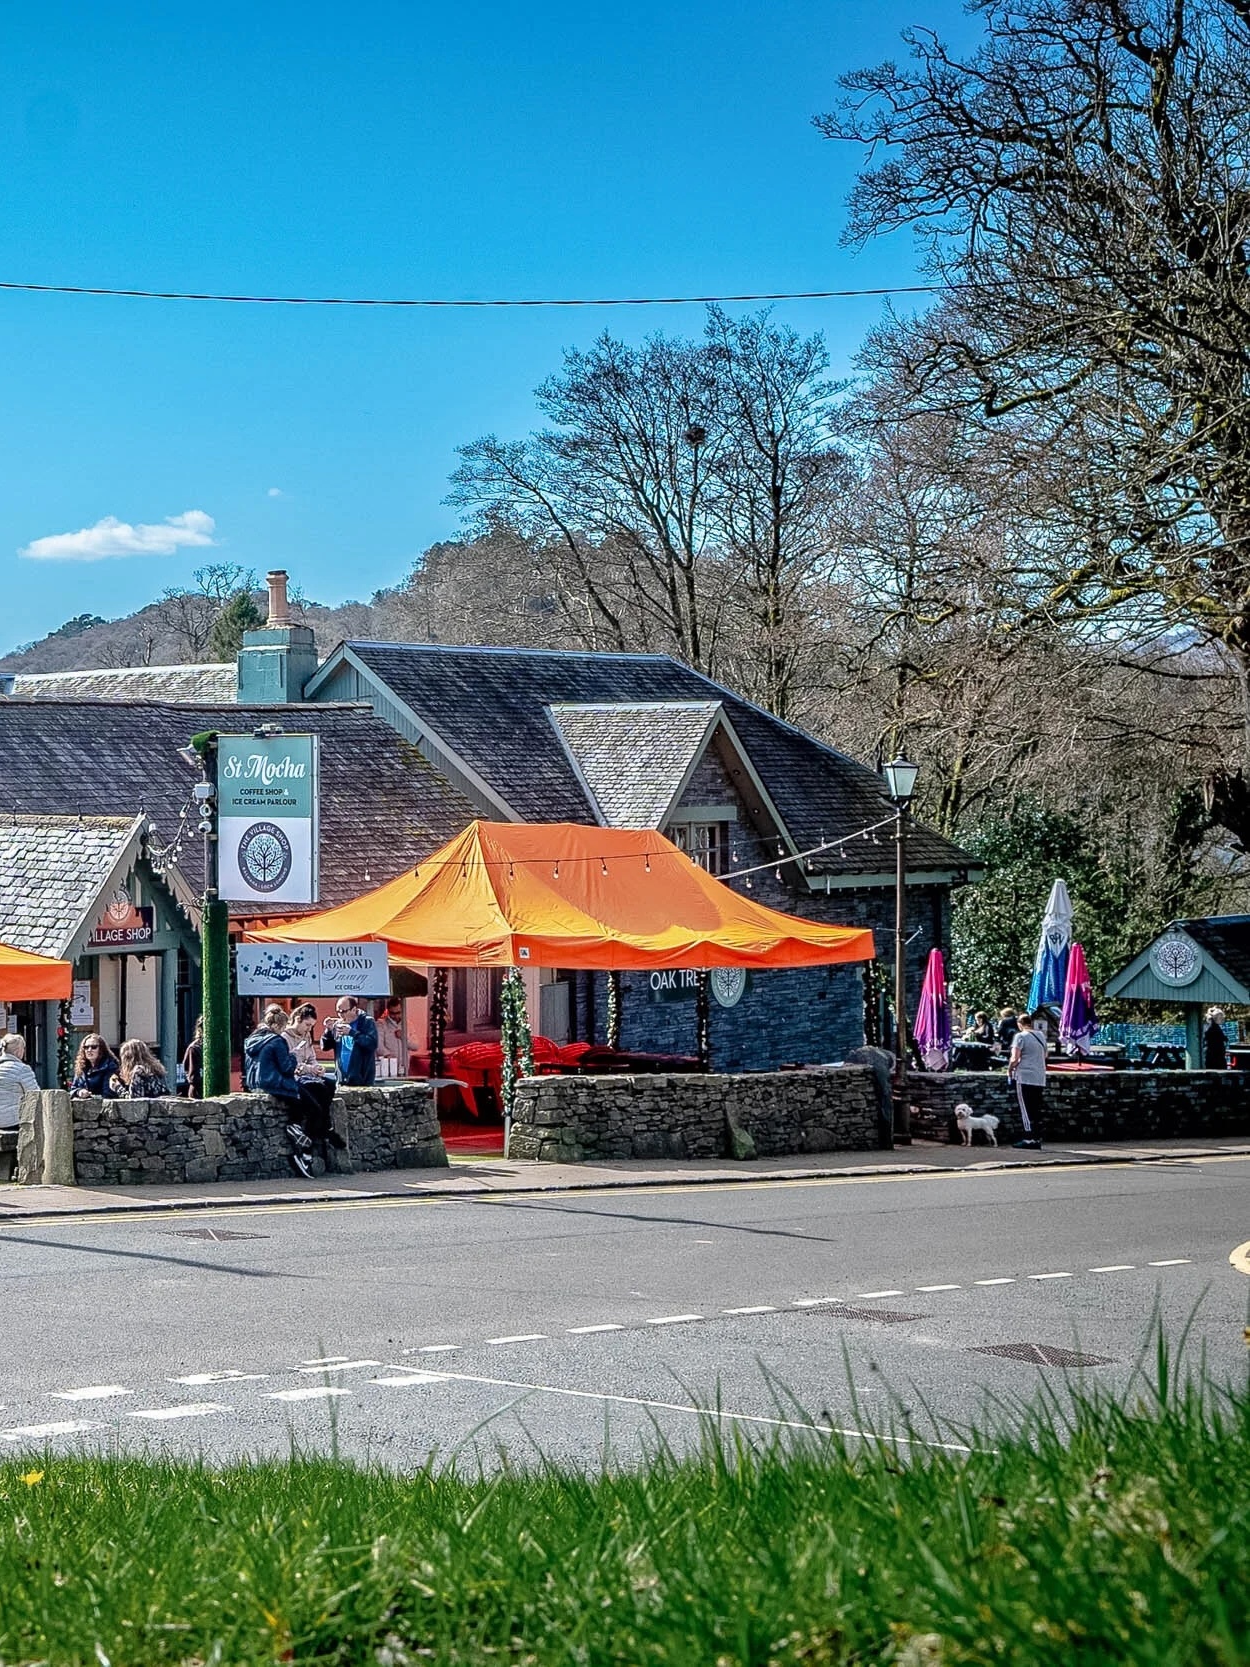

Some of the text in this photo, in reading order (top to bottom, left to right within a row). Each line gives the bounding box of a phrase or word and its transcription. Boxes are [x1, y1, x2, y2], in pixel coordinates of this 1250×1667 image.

[223, 754, 306, 785] St Mocha
[240, 788, 289, 796] COFFEE SHOP &
[232, 798, 297, 806] ICE CREAM PARLOUR
[241, 824, 290, 850] THE VILLAGE SHOP
[126, 927, 151, 940] SHOP
[329, 945, 362, 957] LOCH
[321, 958, 373, 970] LOMOND
[253, 964, 308, 979] Balmooha
[650, 969, 700, 990] OAK TRE
[334, 983, 361, 991] ICE CREAM
